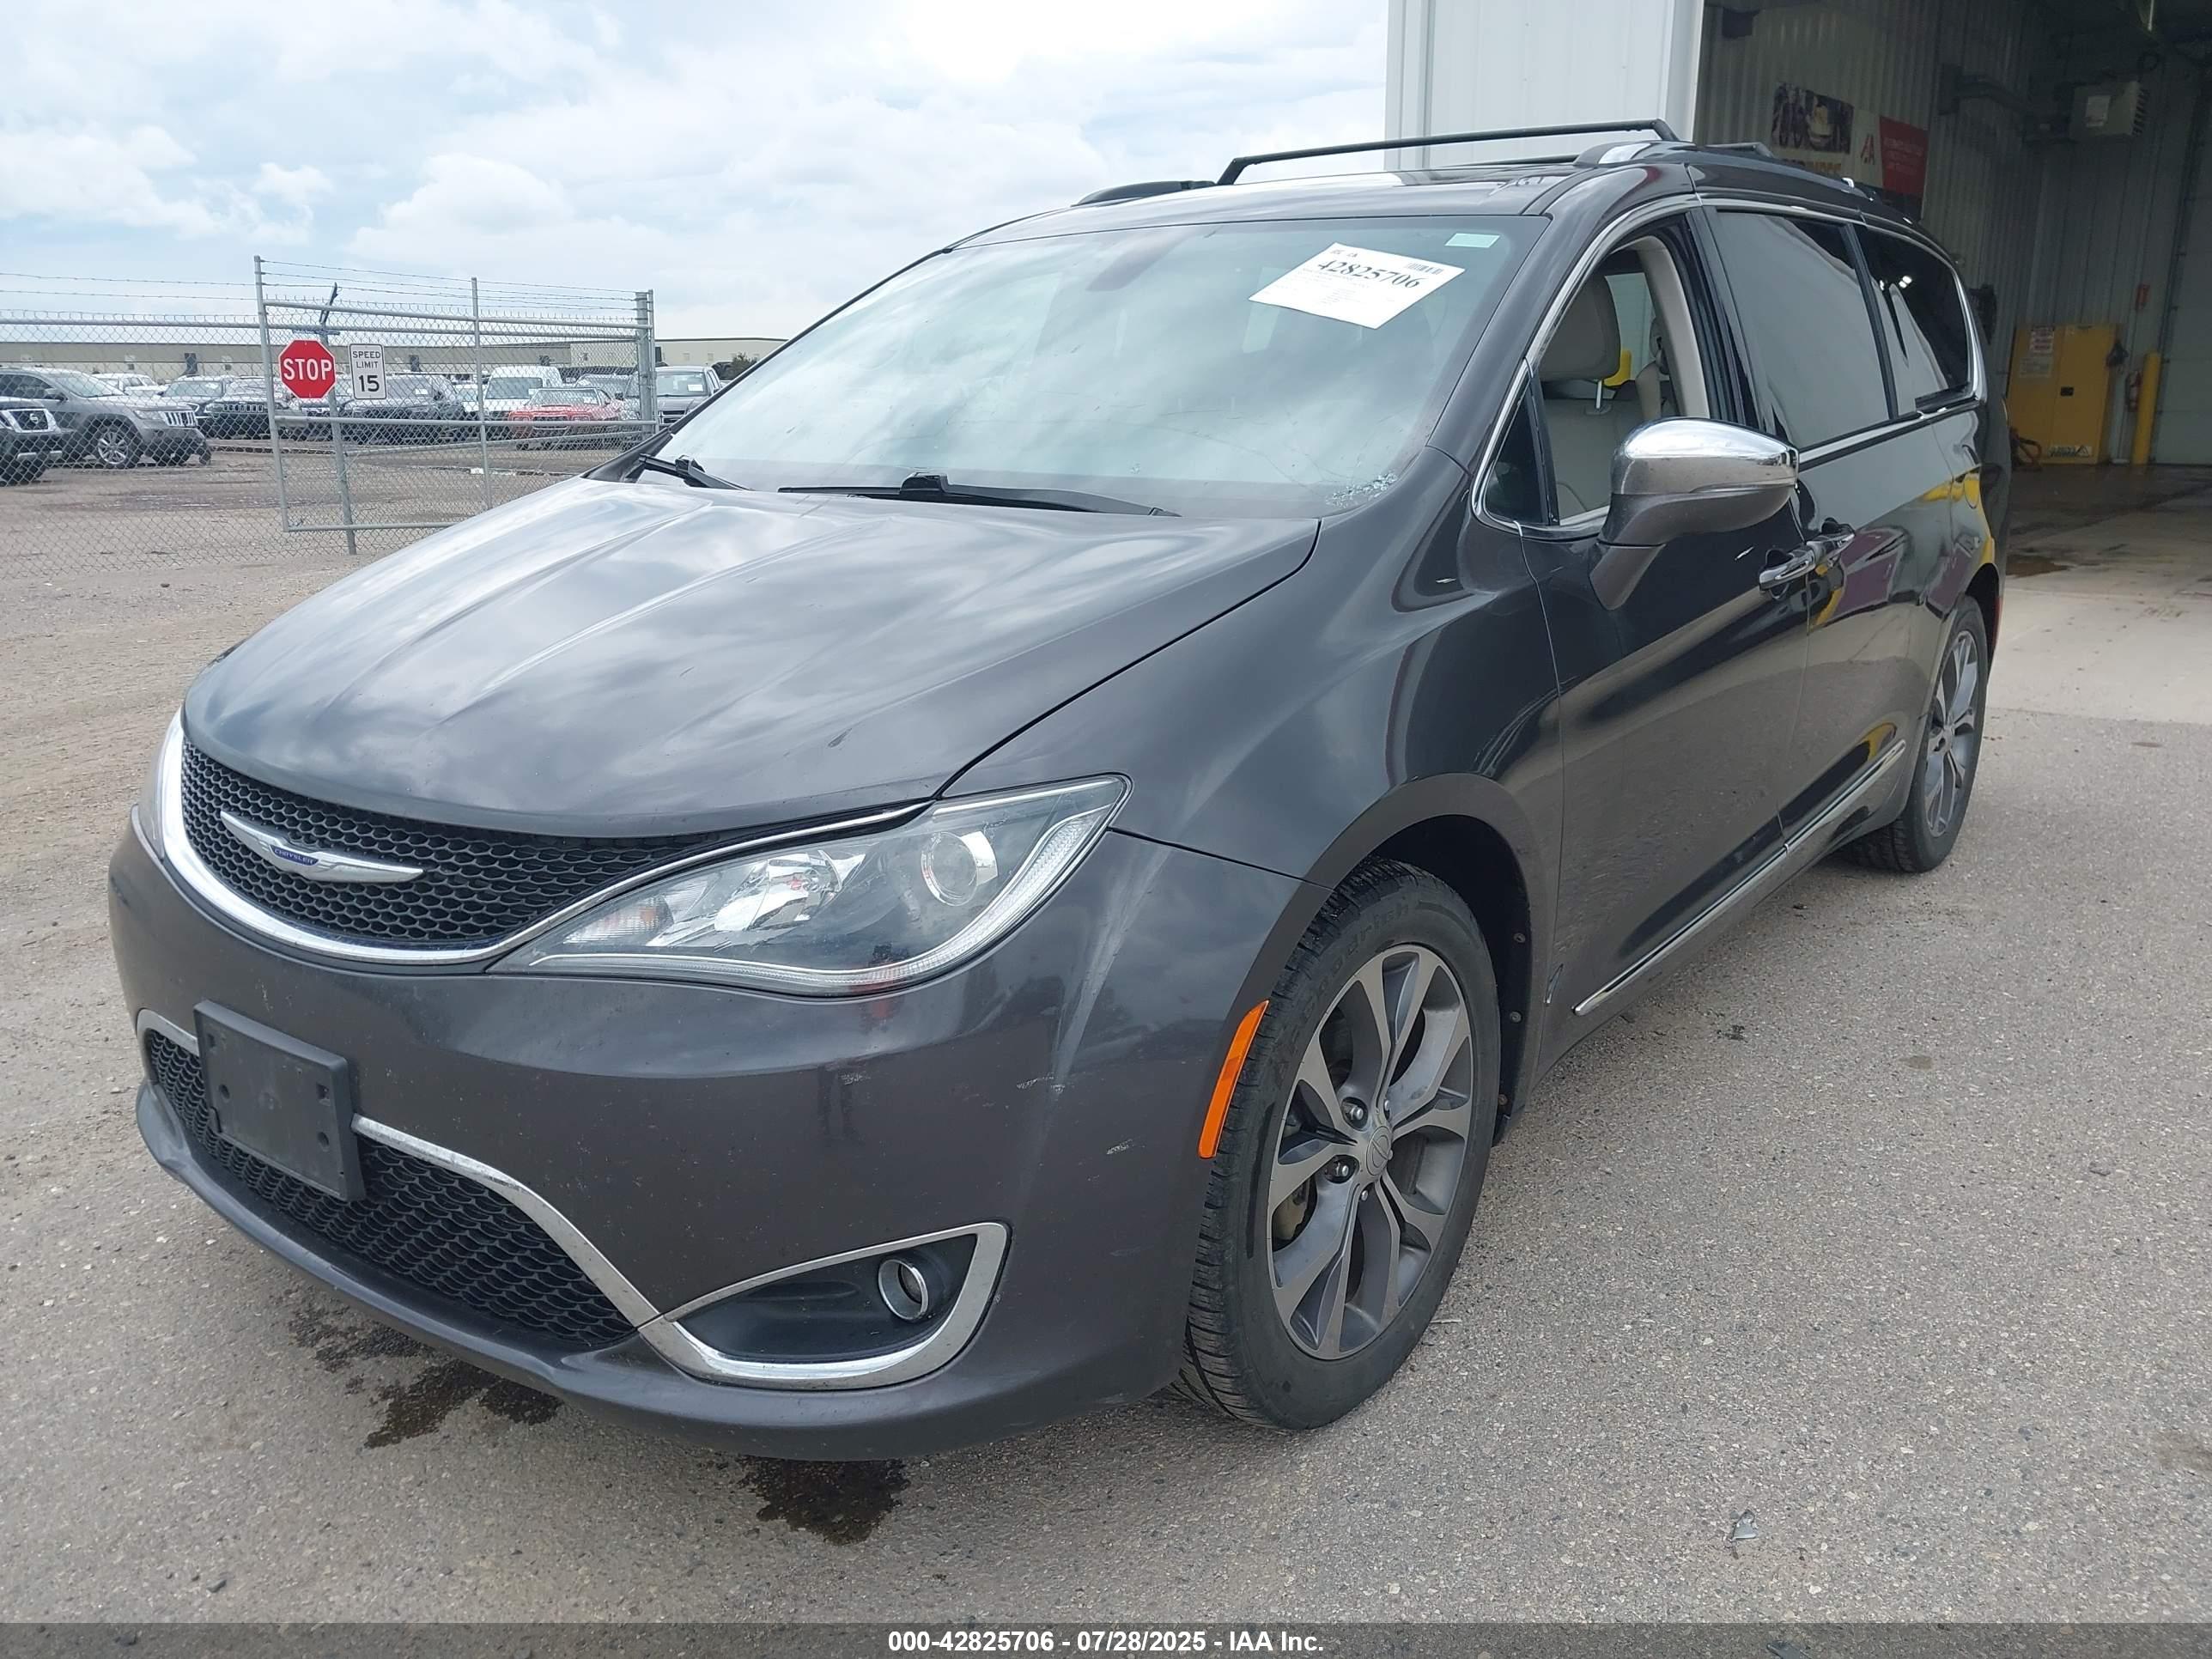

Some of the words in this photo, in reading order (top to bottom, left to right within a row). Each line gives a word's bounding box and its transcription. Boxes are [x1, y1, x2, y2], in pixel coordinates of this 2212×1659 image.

[1318, 260, 1423, 288] 42825706
[283, 359, 331, 380] STOP
[359, 375, 380, 392] 15
[275, 848, 313, 864] CHRYSLER
